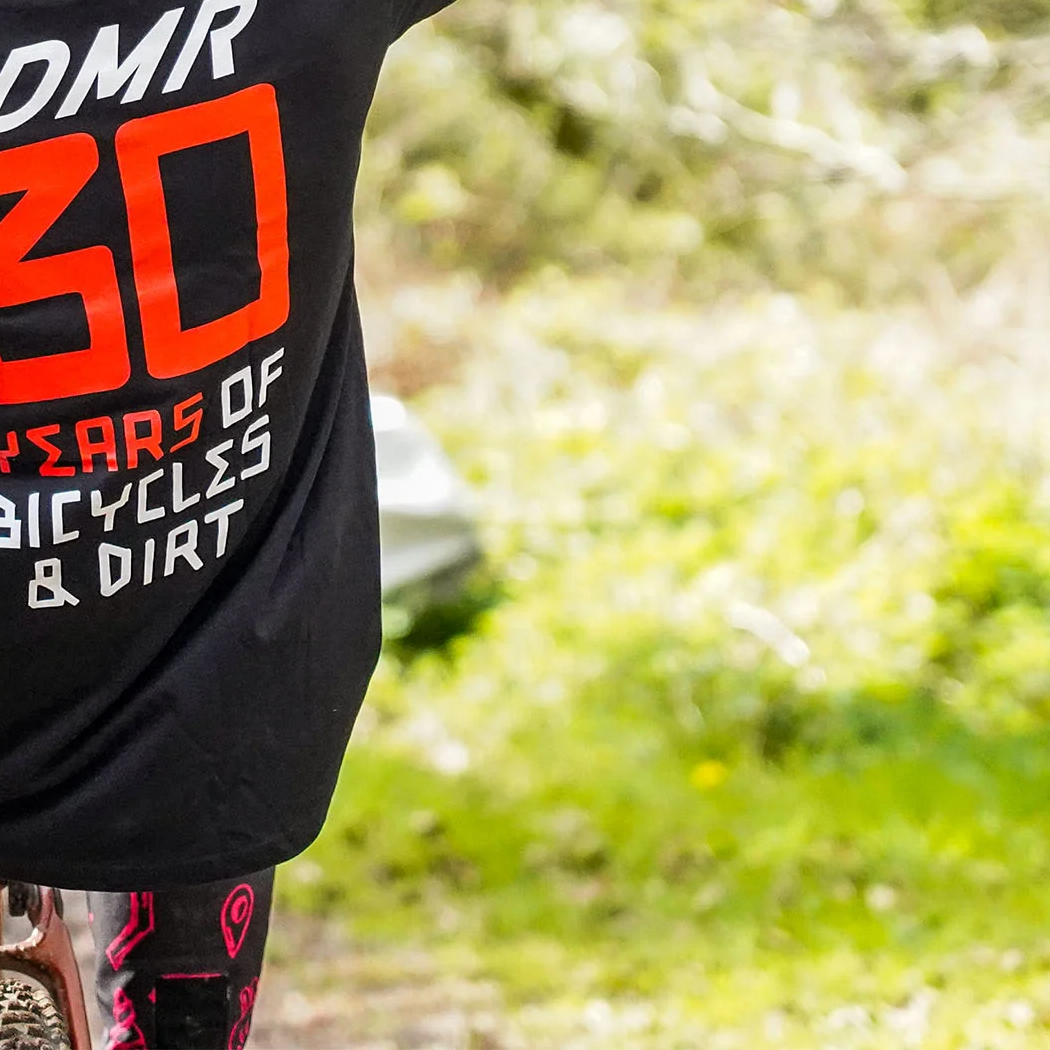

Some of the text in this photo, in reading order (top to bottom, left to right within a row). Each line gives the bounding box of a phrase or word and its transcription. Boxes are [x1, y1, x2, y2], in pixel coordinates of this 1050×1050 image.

[220, 346, 285, 429] OF
[27, 498, 245, 609] & DIRT
